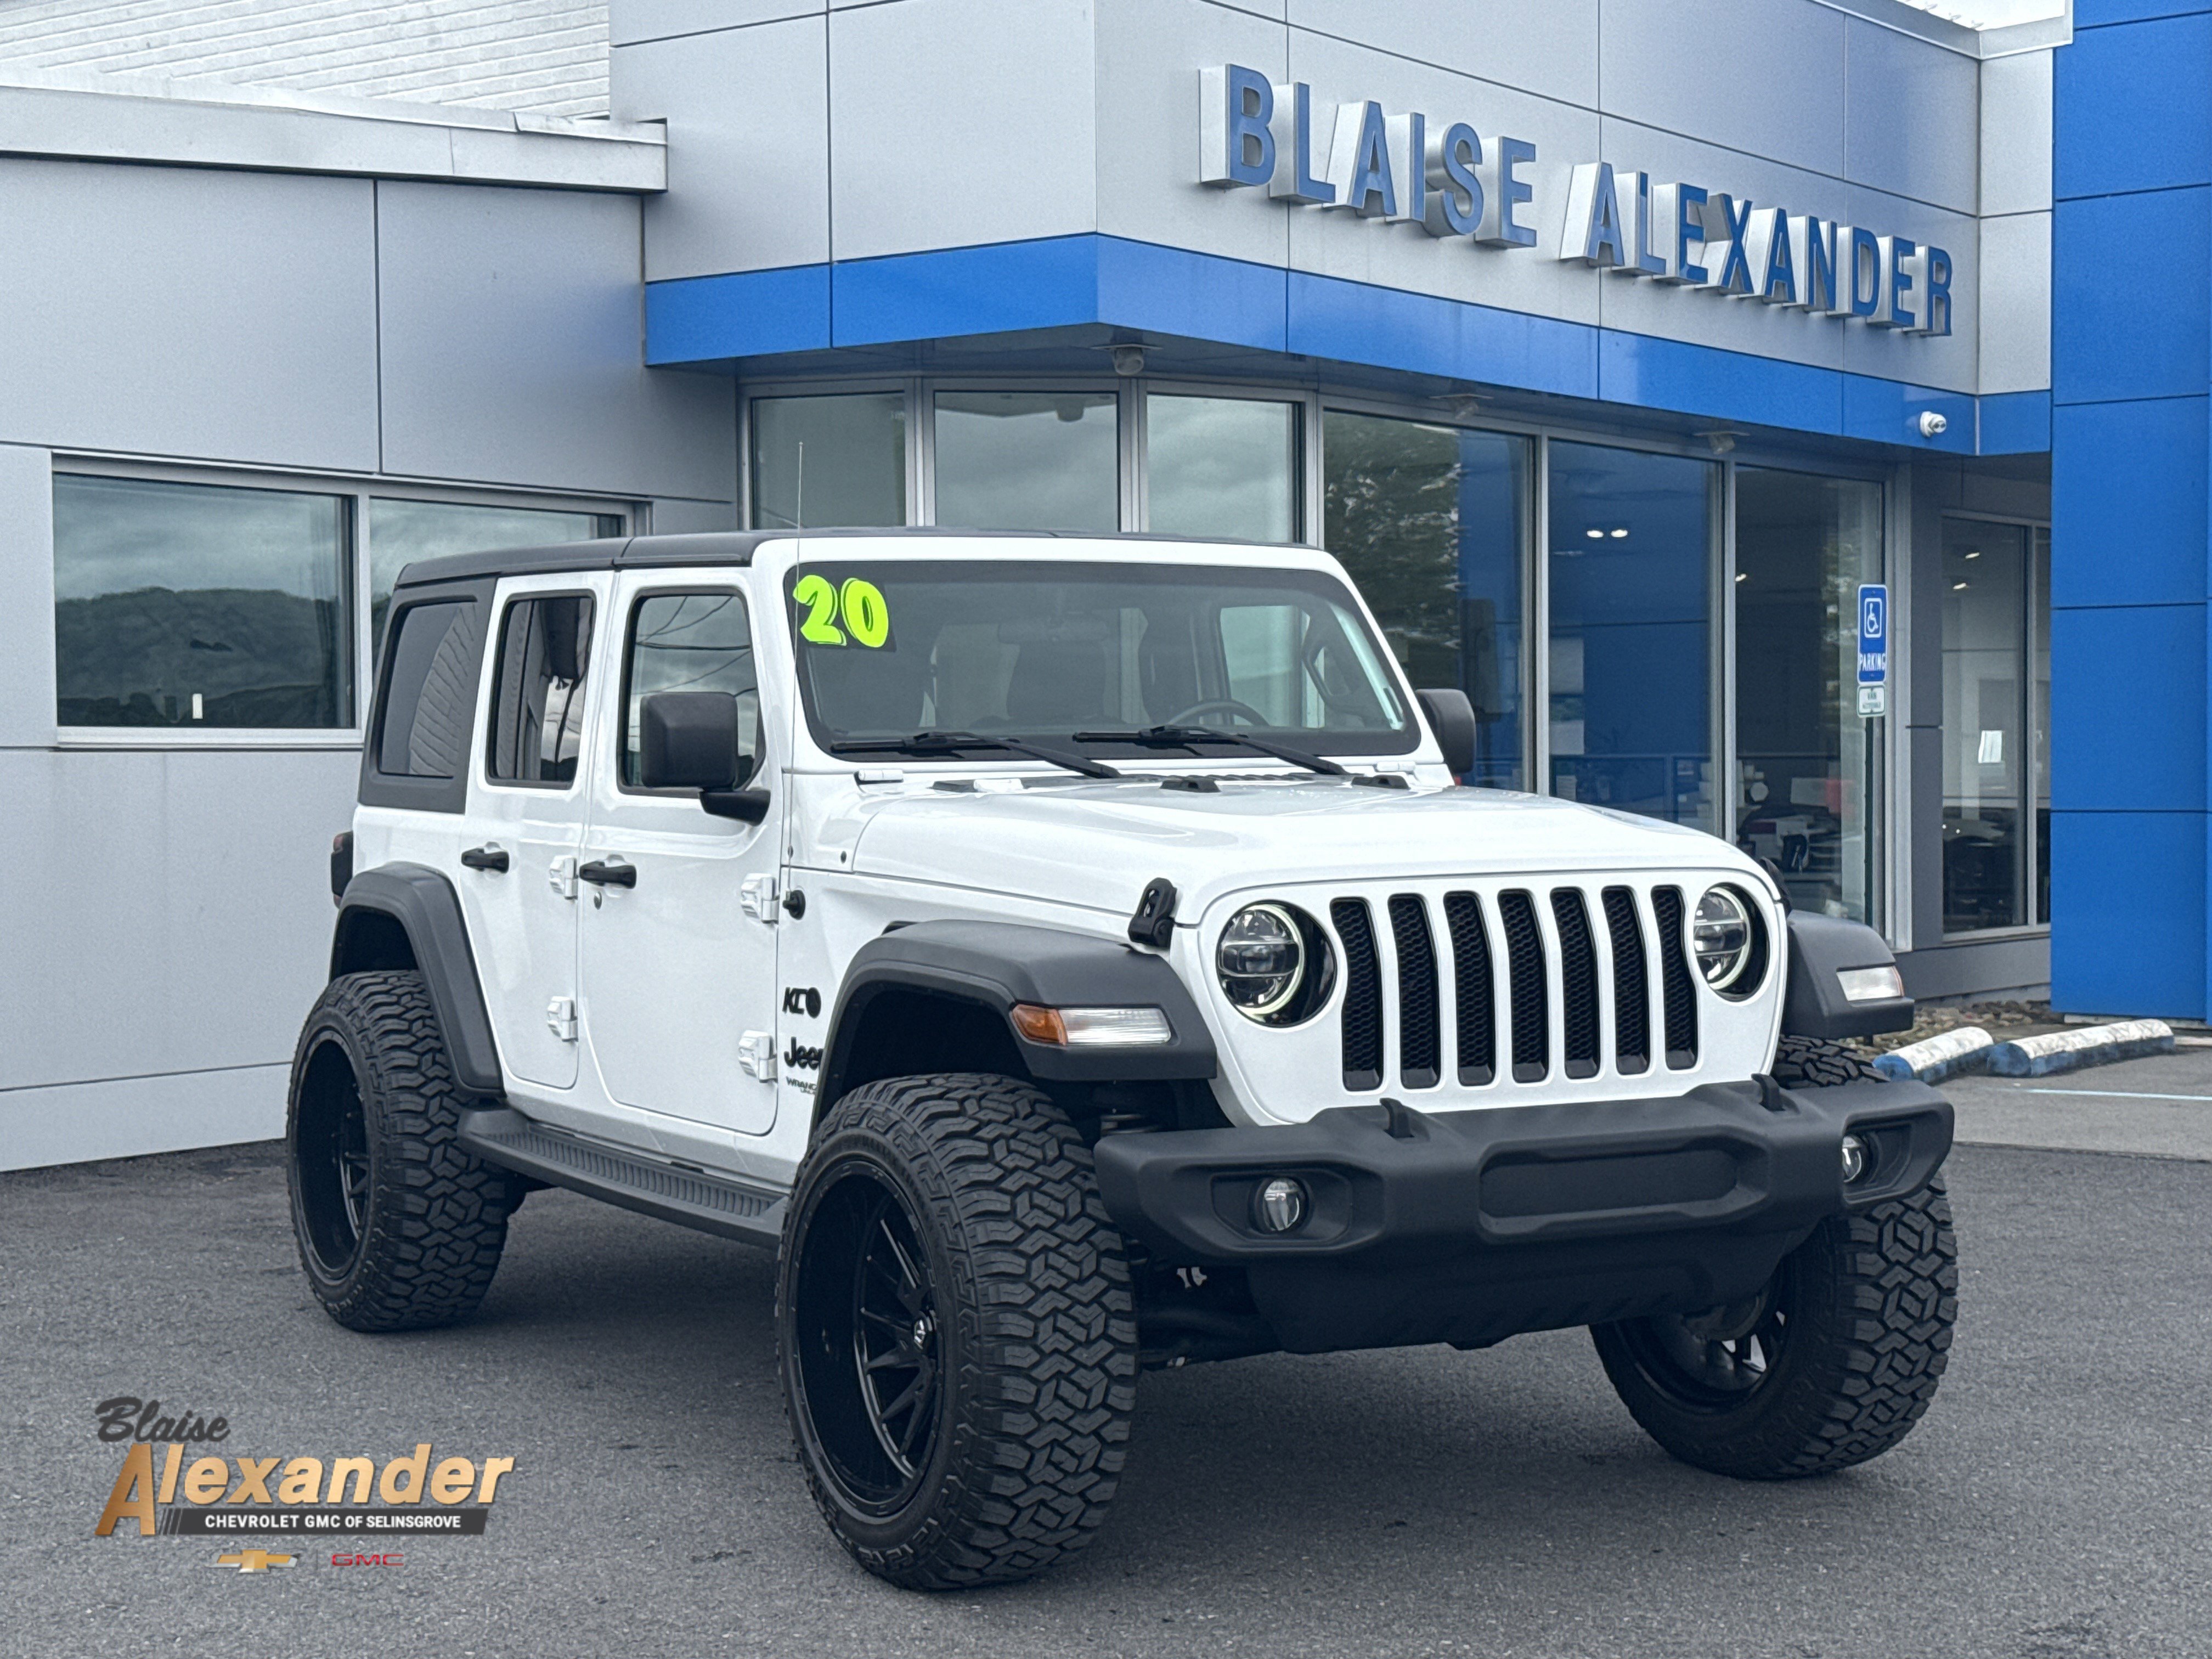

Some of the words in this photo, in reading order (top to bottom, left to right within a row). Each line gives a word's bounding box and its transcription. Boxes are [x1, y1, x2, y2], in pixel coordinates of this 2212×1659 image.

[1224, 63, 1537, 248] BLAISE
[1585, 161, 1953, 336] ALEXANDER
[793, 574, 889, 648] 20
[1859, 652, 1886, 672] PARKING
[785, 1075, 817, 1090] WRANG
